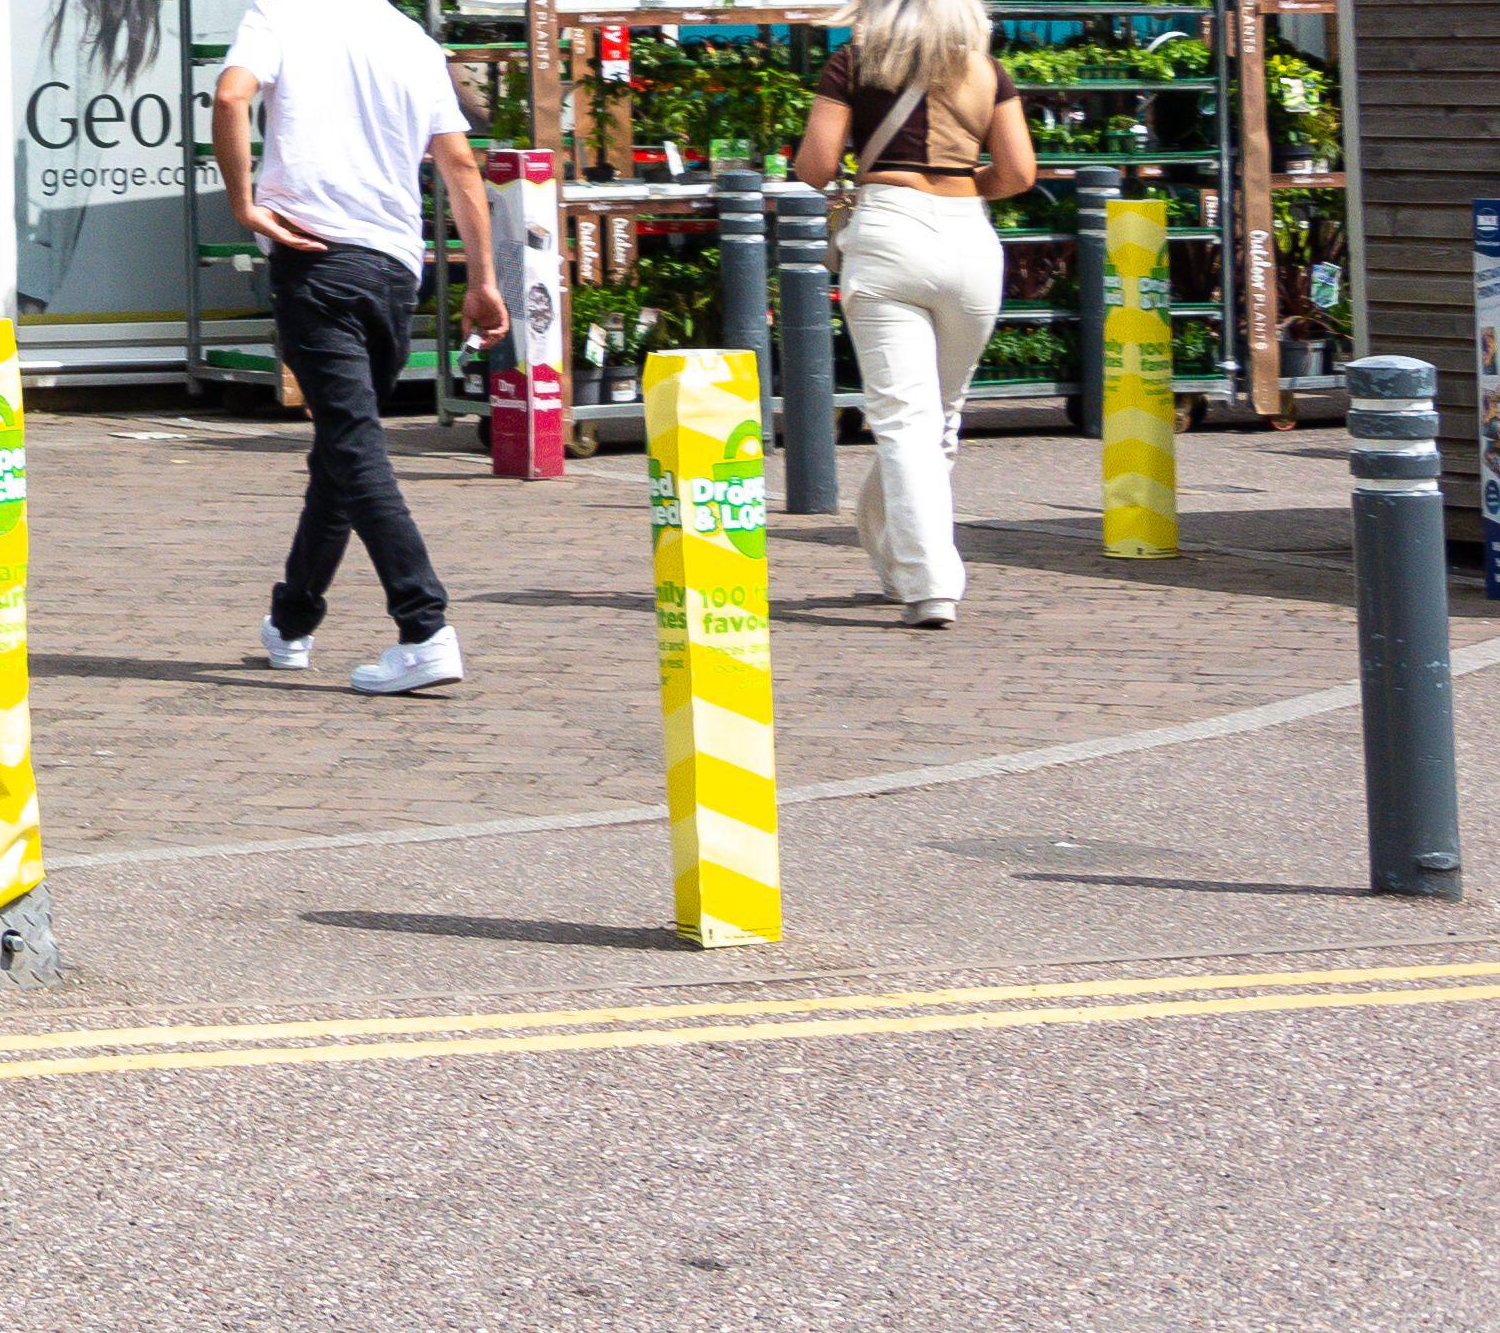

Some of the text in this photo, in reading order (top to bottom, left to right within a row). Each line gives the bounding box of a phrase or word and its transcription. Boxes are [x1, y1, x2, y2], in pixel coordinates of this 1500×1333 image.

[535, 11, 550, 70] PLANTS
[1253, 293, 1268, 350] PLANTS
[695, 504, 717, 533] &
[699, 585, 746, 609] 100
